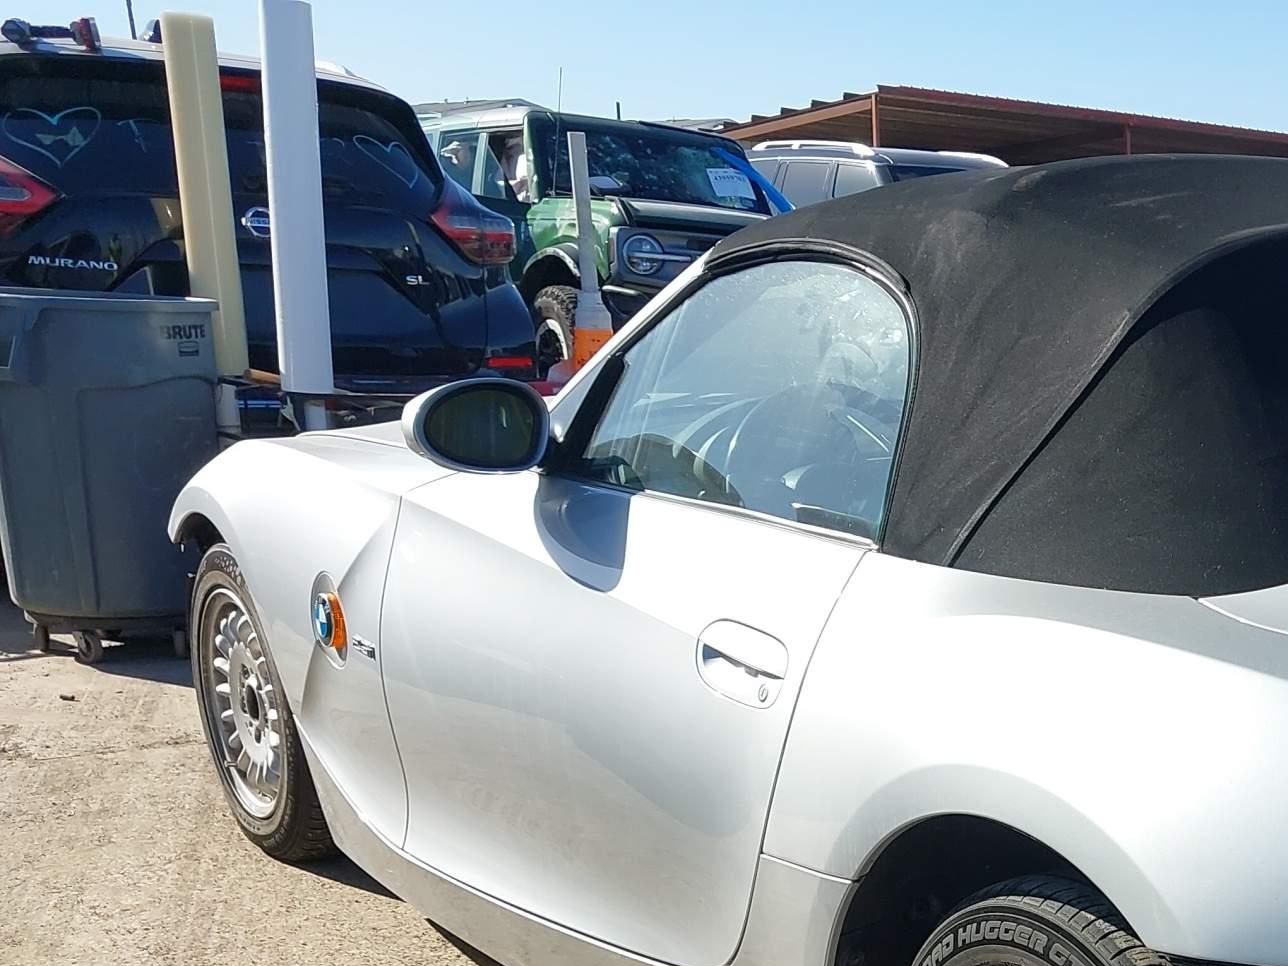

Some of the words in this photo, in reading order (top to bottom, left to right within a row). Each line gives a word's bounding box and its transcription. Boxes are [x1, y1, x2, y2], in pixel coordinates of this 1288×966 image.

[28, 255, 119, 271] MURANO
[406, 275, 431, 286] SL
[957, 920, 1049, 954] HUGGER
